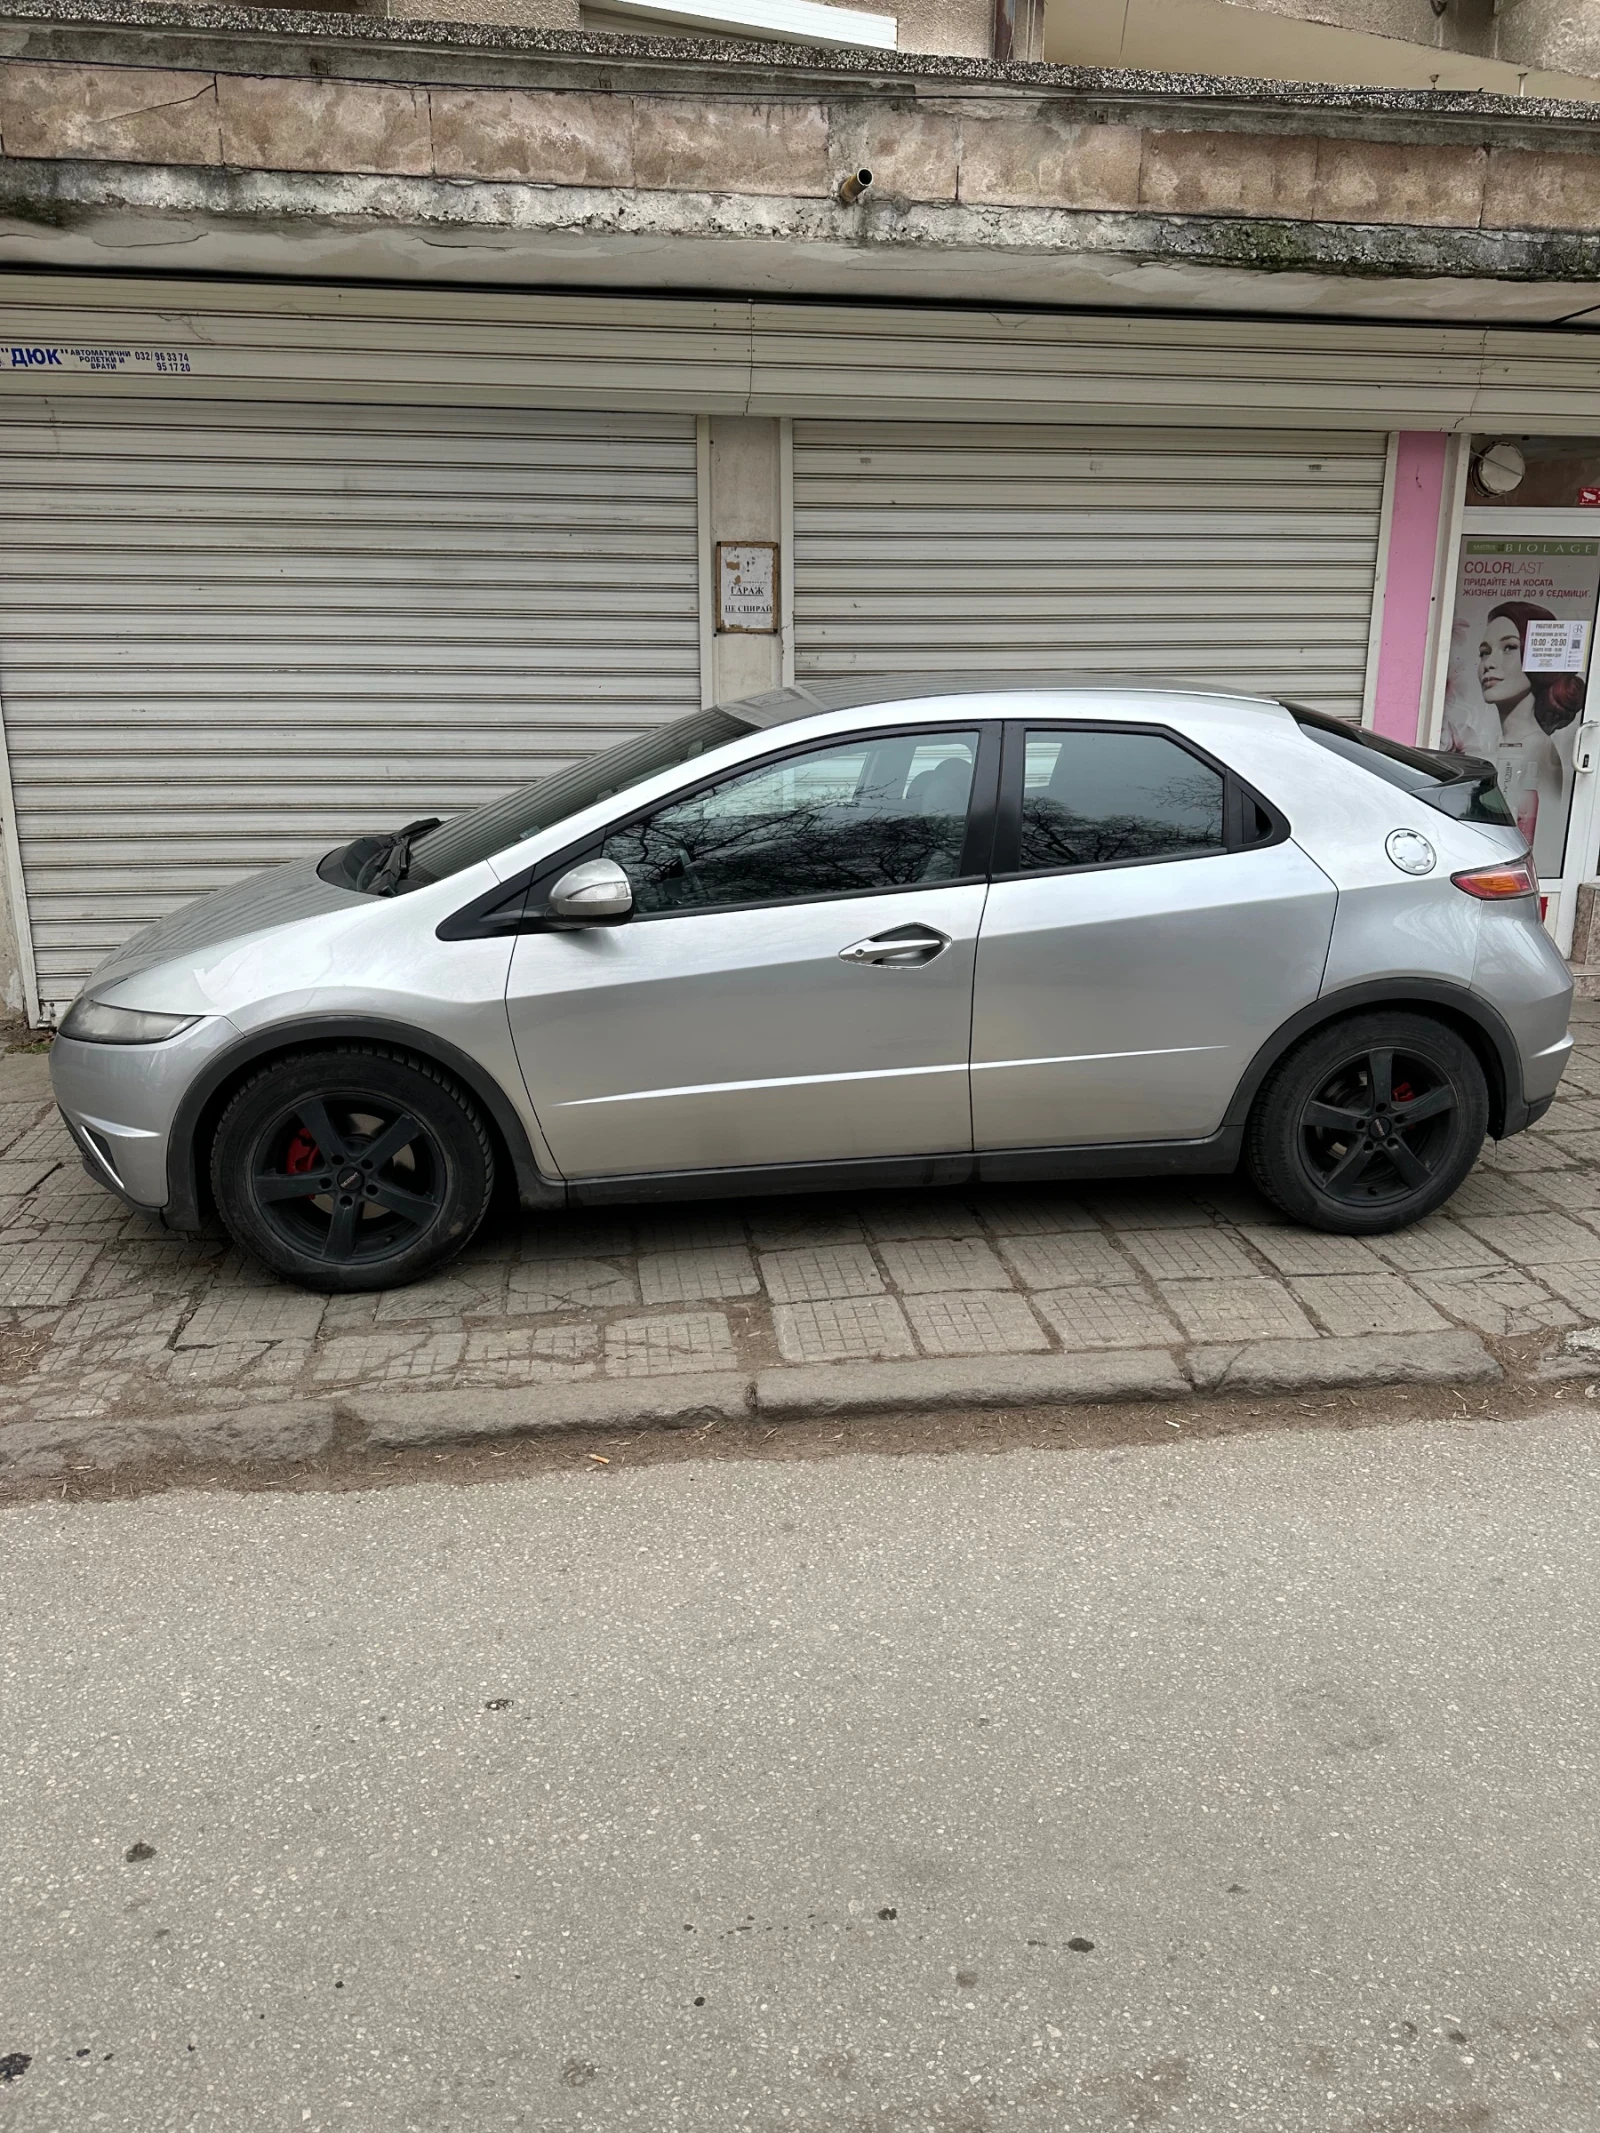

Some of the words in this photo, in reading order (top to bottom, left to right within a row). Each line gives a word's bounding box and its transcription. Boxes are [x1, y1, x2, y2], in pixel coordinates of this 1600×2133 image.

[70, 349, 131, 357] АВТОМАТИЧНИ
[154, 352, 165, 361] 96
[166, 352, 177, 362] 33
[178, 353, 189, 362] 74
[79, 355, 117, 363] РОЛЕТКИ
[90, 362, 117, 370] ВРАТИ
[156, 362, 168, 371] 95
[169, 362, 179, 372] 17
[180, 363, 191, 372] 20
[1505, 543, 1593, 554] BIOLAGE
[1464, 561, 1544, 574] COLORLAST
[1463, 577, 1506, 587] ПРИДАЙТЕ
[1509, 579, 1521, 587] НА
[1523, 579, 1553, 587] КОСАТА
[730, 586, 765, 596] ГАРАЖ
[1462, 589, 1498, 597] ЖИЗНЕН
[1500, 589, 1521, 598] ЦВЯТ
[1523, 589, 1536, 598] ДО
[725, 604, 735, 613] НЕ
[738, 604, 772, 613] СПИРАЙ
[1531, 638, 1546, 647] 10:00
[1550, 638, 1567, 647] 20:00
